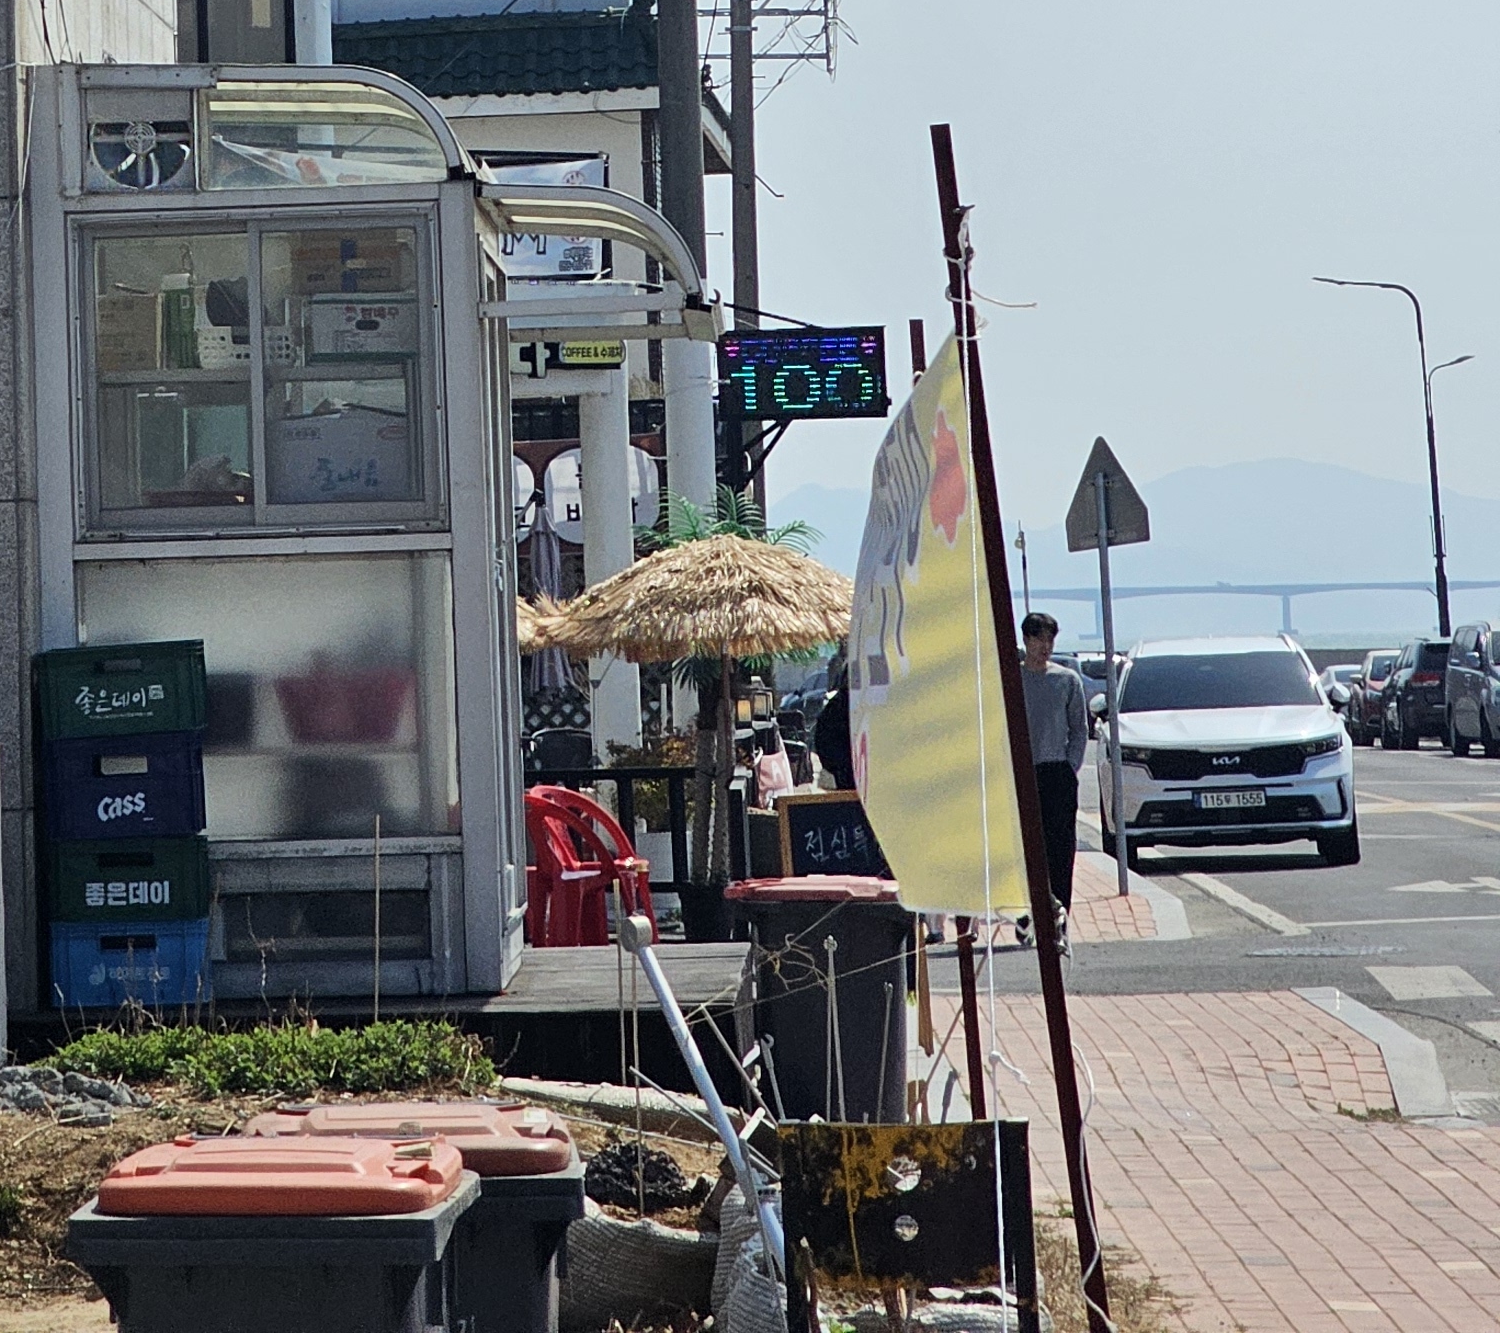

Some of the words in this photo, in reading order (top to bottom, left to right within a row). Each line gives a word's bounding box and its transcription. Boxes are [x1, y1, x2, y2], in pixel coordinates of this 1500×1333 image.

[75, 686, 147, 715] 좋은데이
[1235, 792, 1263, 806] 1555
[85, 880, 170, 907] 좋은데이
